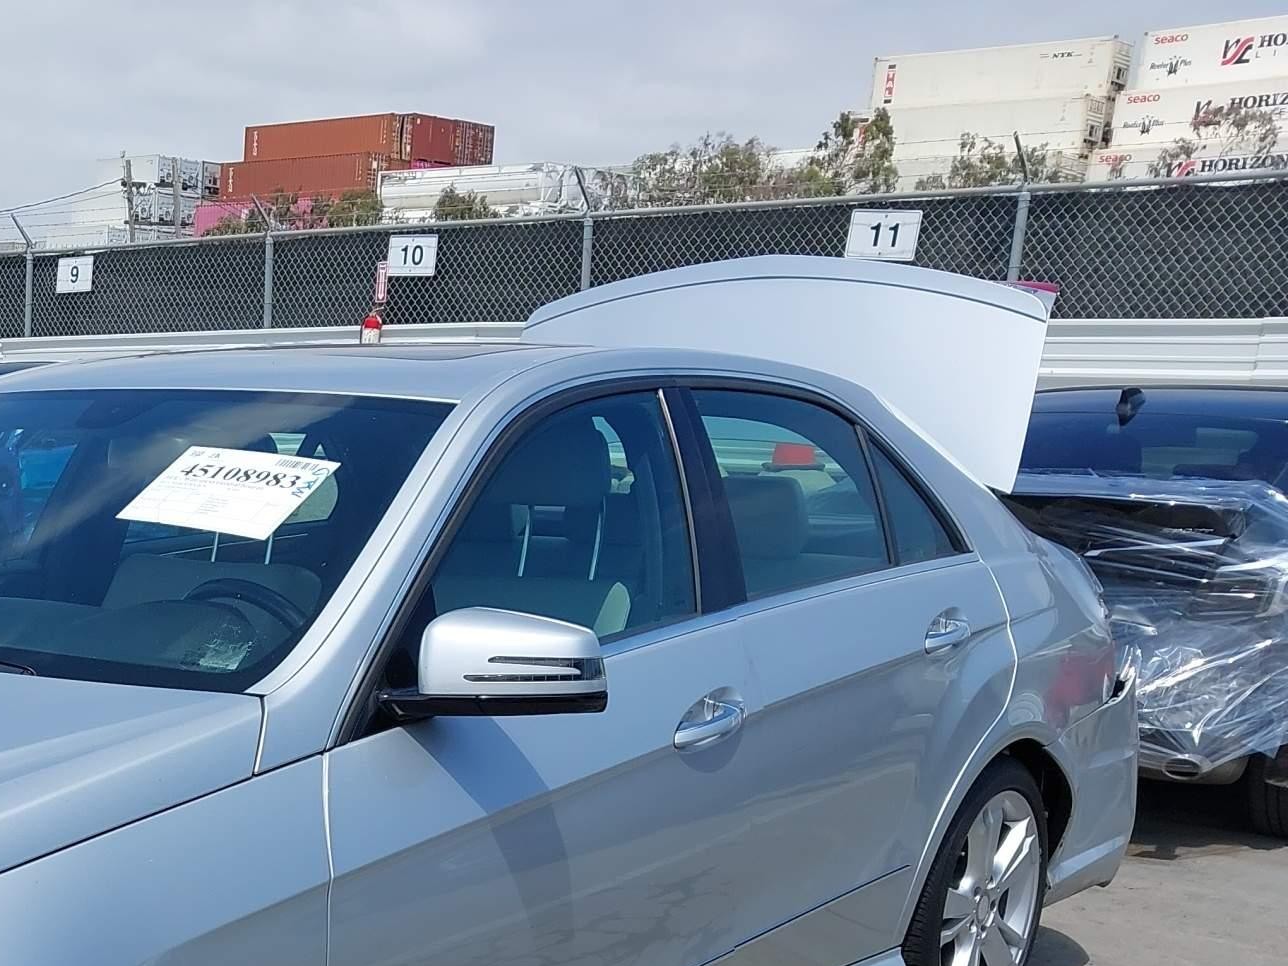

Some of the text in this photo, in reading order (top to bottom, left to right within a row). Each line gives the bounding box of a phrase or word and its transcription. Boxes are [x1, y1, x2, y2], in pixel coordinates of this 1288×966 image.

[1154, 33, 1189, 45] seaco
[1258, 32, 1288, 48] HO
[1052, 51, 1073, 59] NYK
[885, 71, 895, 97] TAL
[1127, 93, 1160, 105] seaco
[1098, 153, 1132, 163] seaco
[870, 222, 900, 247] 11
[401, 244, 424, 265] 10
[70, 265, 79, 284] 9
[180, 463, 301, 489] 45108983
